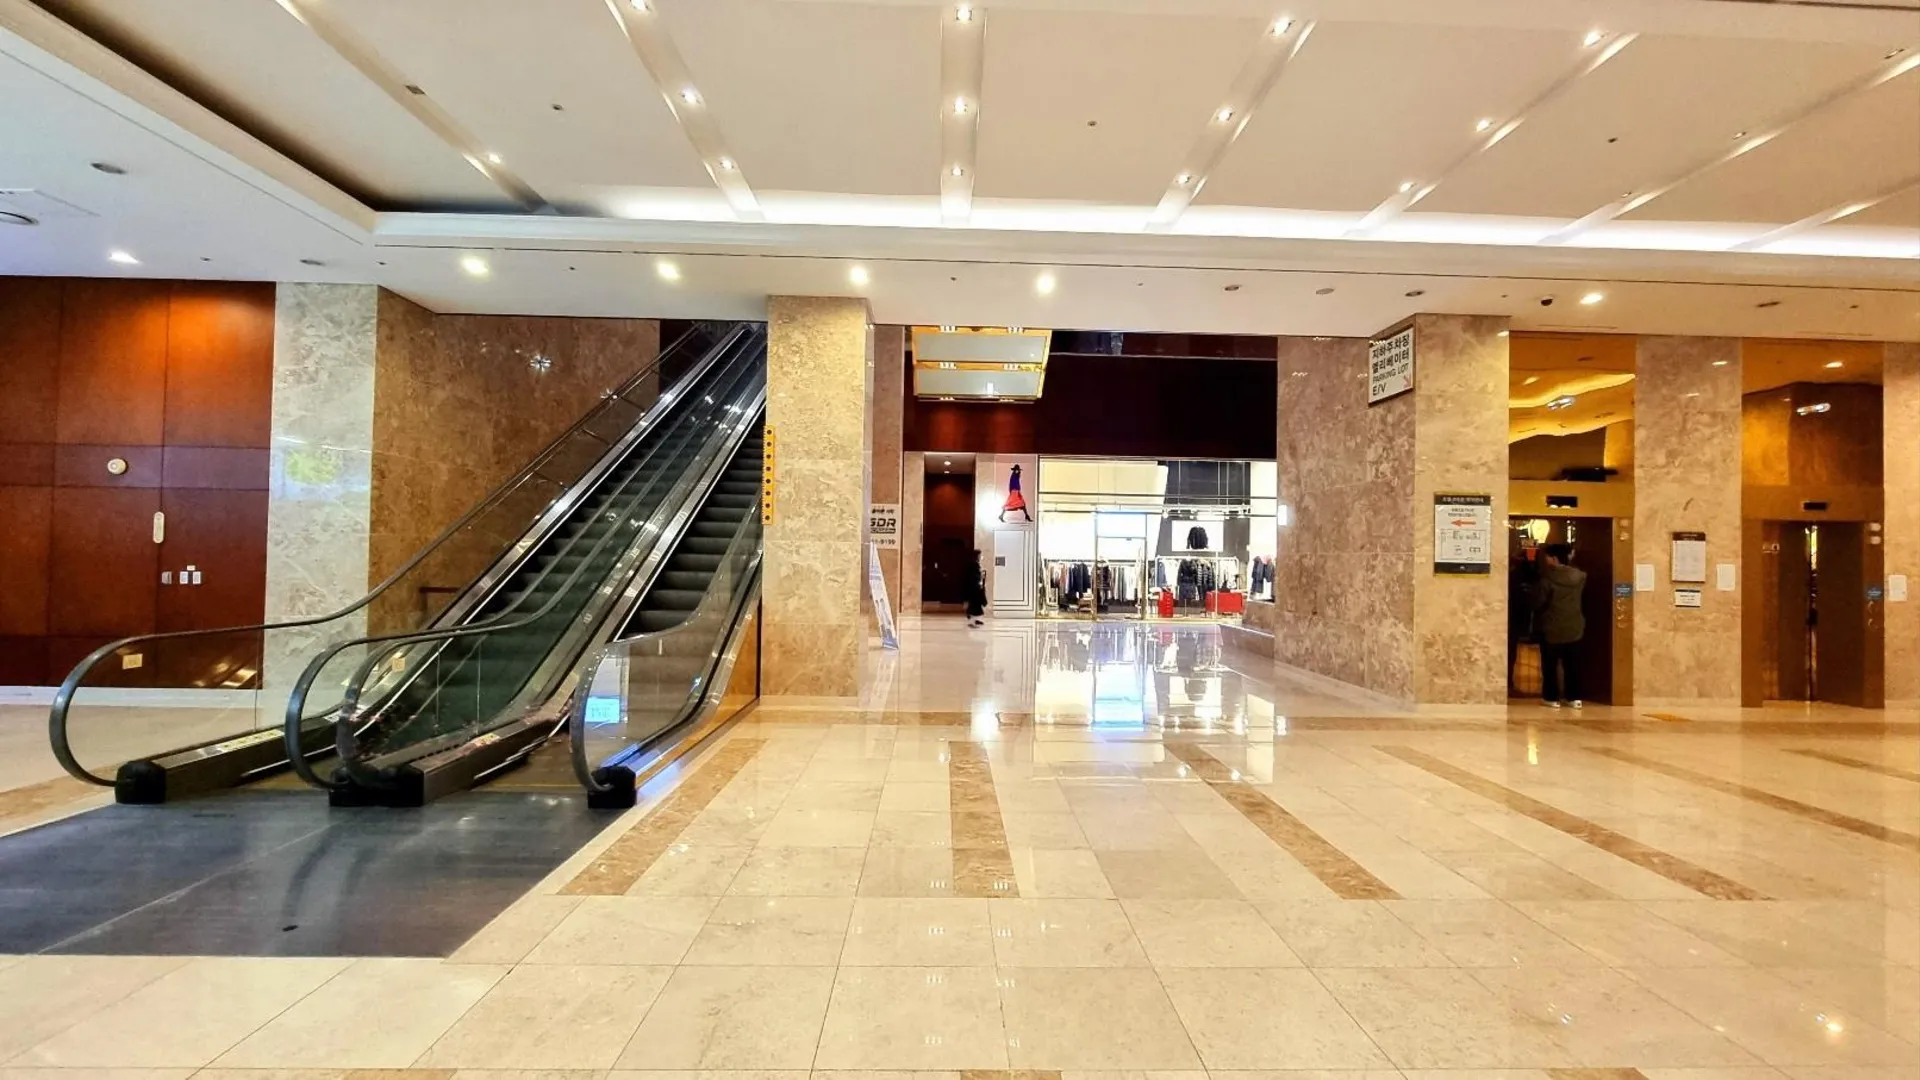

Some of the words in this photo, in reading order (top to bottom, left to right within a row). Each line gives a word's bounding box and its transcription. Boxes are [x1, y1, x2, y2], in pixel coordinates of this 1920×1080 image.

[1372, 333, 1410, 359] 지하주차장
[1372, 348, 1410, 374] 엘리베이터
[1373, 368, 1397, 384] PARKING
[1397, 362, 1409, 375] LOT
[1372, 382, 1387, 396] E/V
